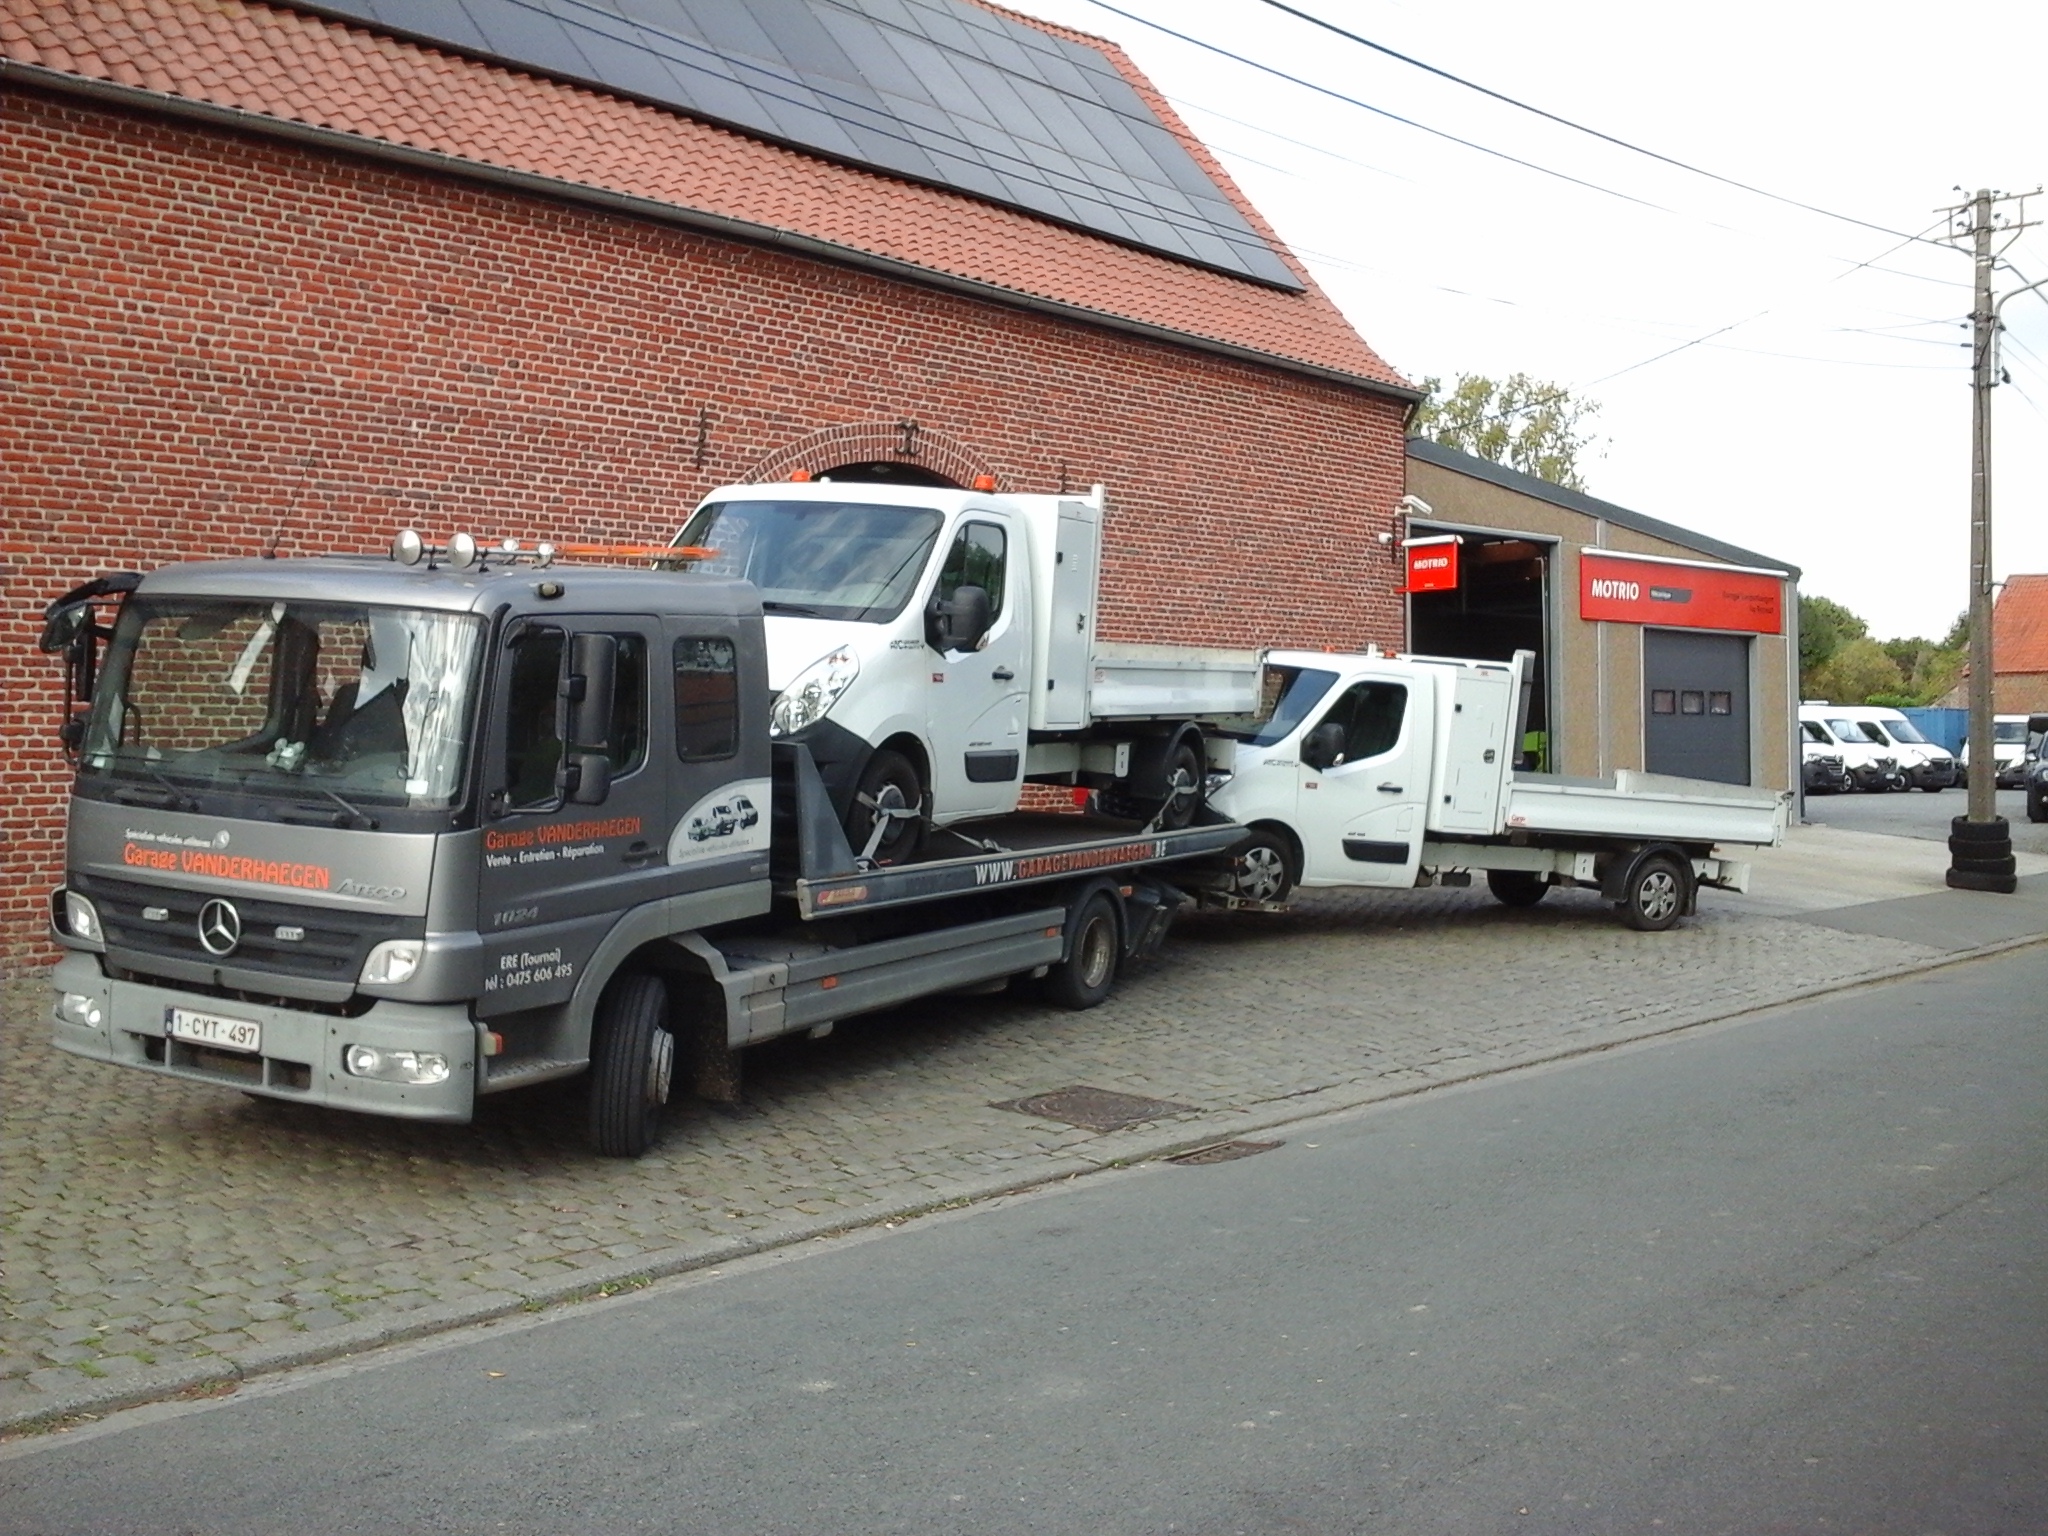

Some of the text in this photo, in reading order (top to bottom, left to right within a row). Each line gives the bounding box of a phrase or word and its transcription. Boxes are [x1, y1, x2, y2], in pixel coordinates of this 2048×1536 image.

[1413, 557, 1449, 570] MOTRIO
[1591, 578, 1640, 601] MOTRIO
[485, 817, 641, 850] Garage VANDERHAEGEN
[124, 842, 329, 889] Garage VANDERHAEGEN
[486, 854, 511, 868] Vente
[500, 954, 518, 970] ERE
[506, 970, 531, 987] 0475
[533, 966, 552, 982] 606
